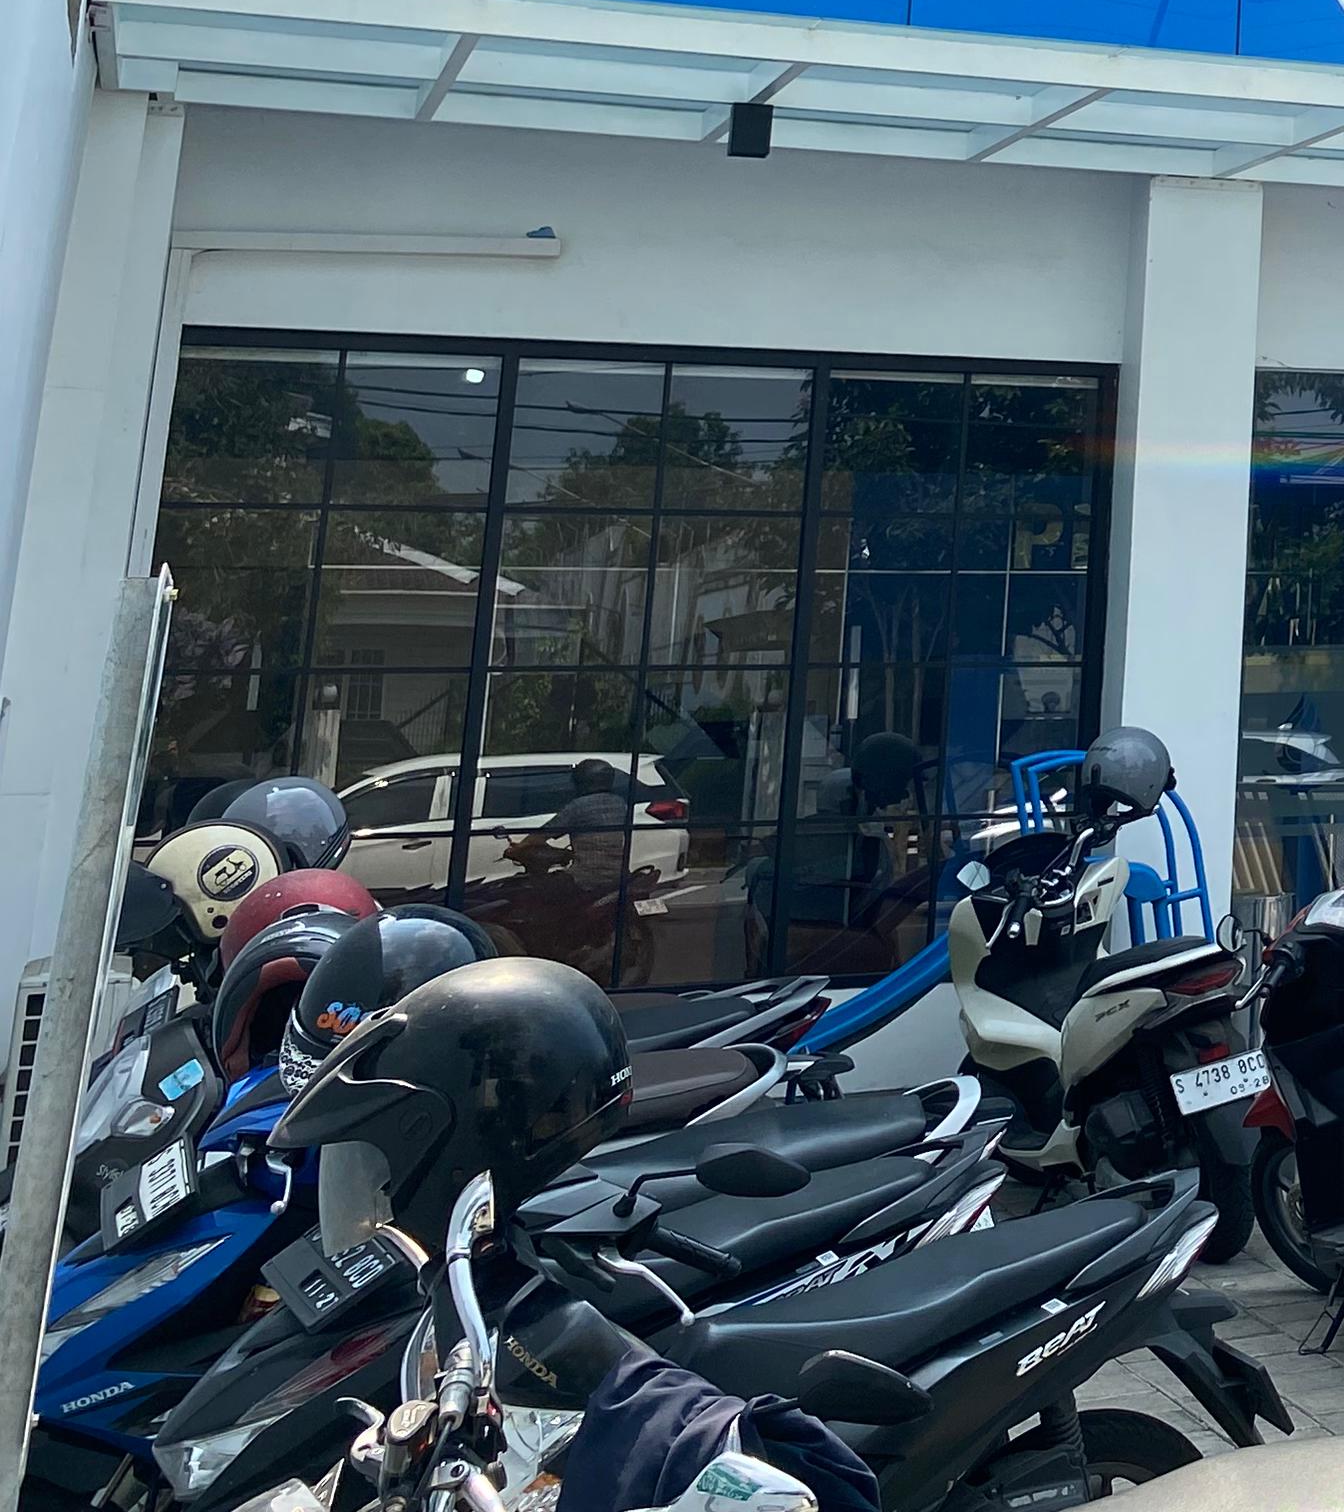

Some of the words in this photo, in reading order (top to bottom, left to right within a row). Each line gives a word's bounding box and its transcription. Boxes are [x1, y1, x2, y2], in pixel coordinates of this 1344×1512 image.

[610, 1065, 633, 1086] HON
[1175, 1079, 1185, 1094] S
[1195, 1064, 1231, 1088] 4738
[504, 1335, 557, 1389] HONDA
[61, 1381, 136, 1413] HONDA
